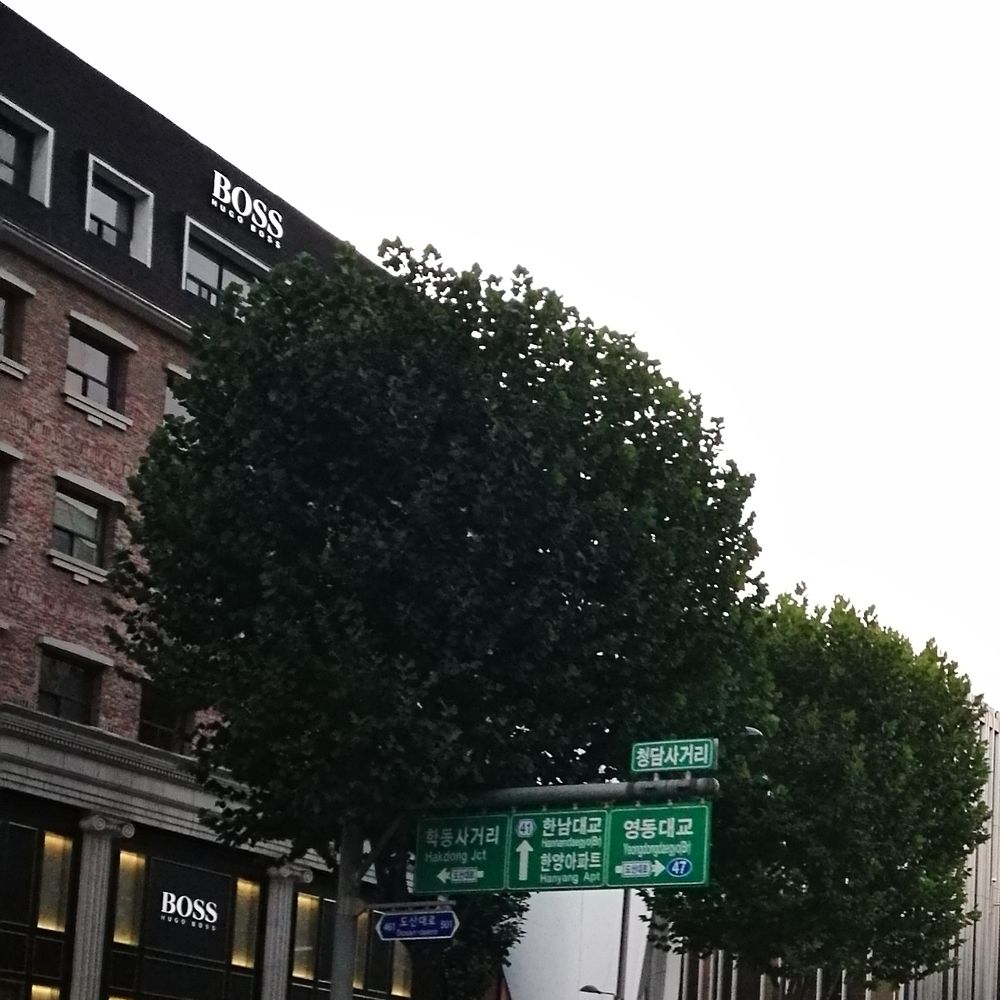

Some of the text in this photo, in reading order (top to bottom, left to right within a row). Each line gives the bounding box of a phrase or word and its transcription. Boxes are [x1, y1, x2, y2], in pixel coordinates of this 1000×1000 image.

[212, 169, 284, 239] BOSS
[211, 198, 281, 249] HUGO BOSS
[636, 743, 708, 767] 청담사거리
[426, 825, 500, 848] 학동사거리
[542, 816, 602, 837] 한남대교
[623, 817, 694, 840] 영동대교
[540, 851, 602, 872] 한양아파트
[671, 860, 687, 874] 47
[161, 891, 218, 923] BOSS
